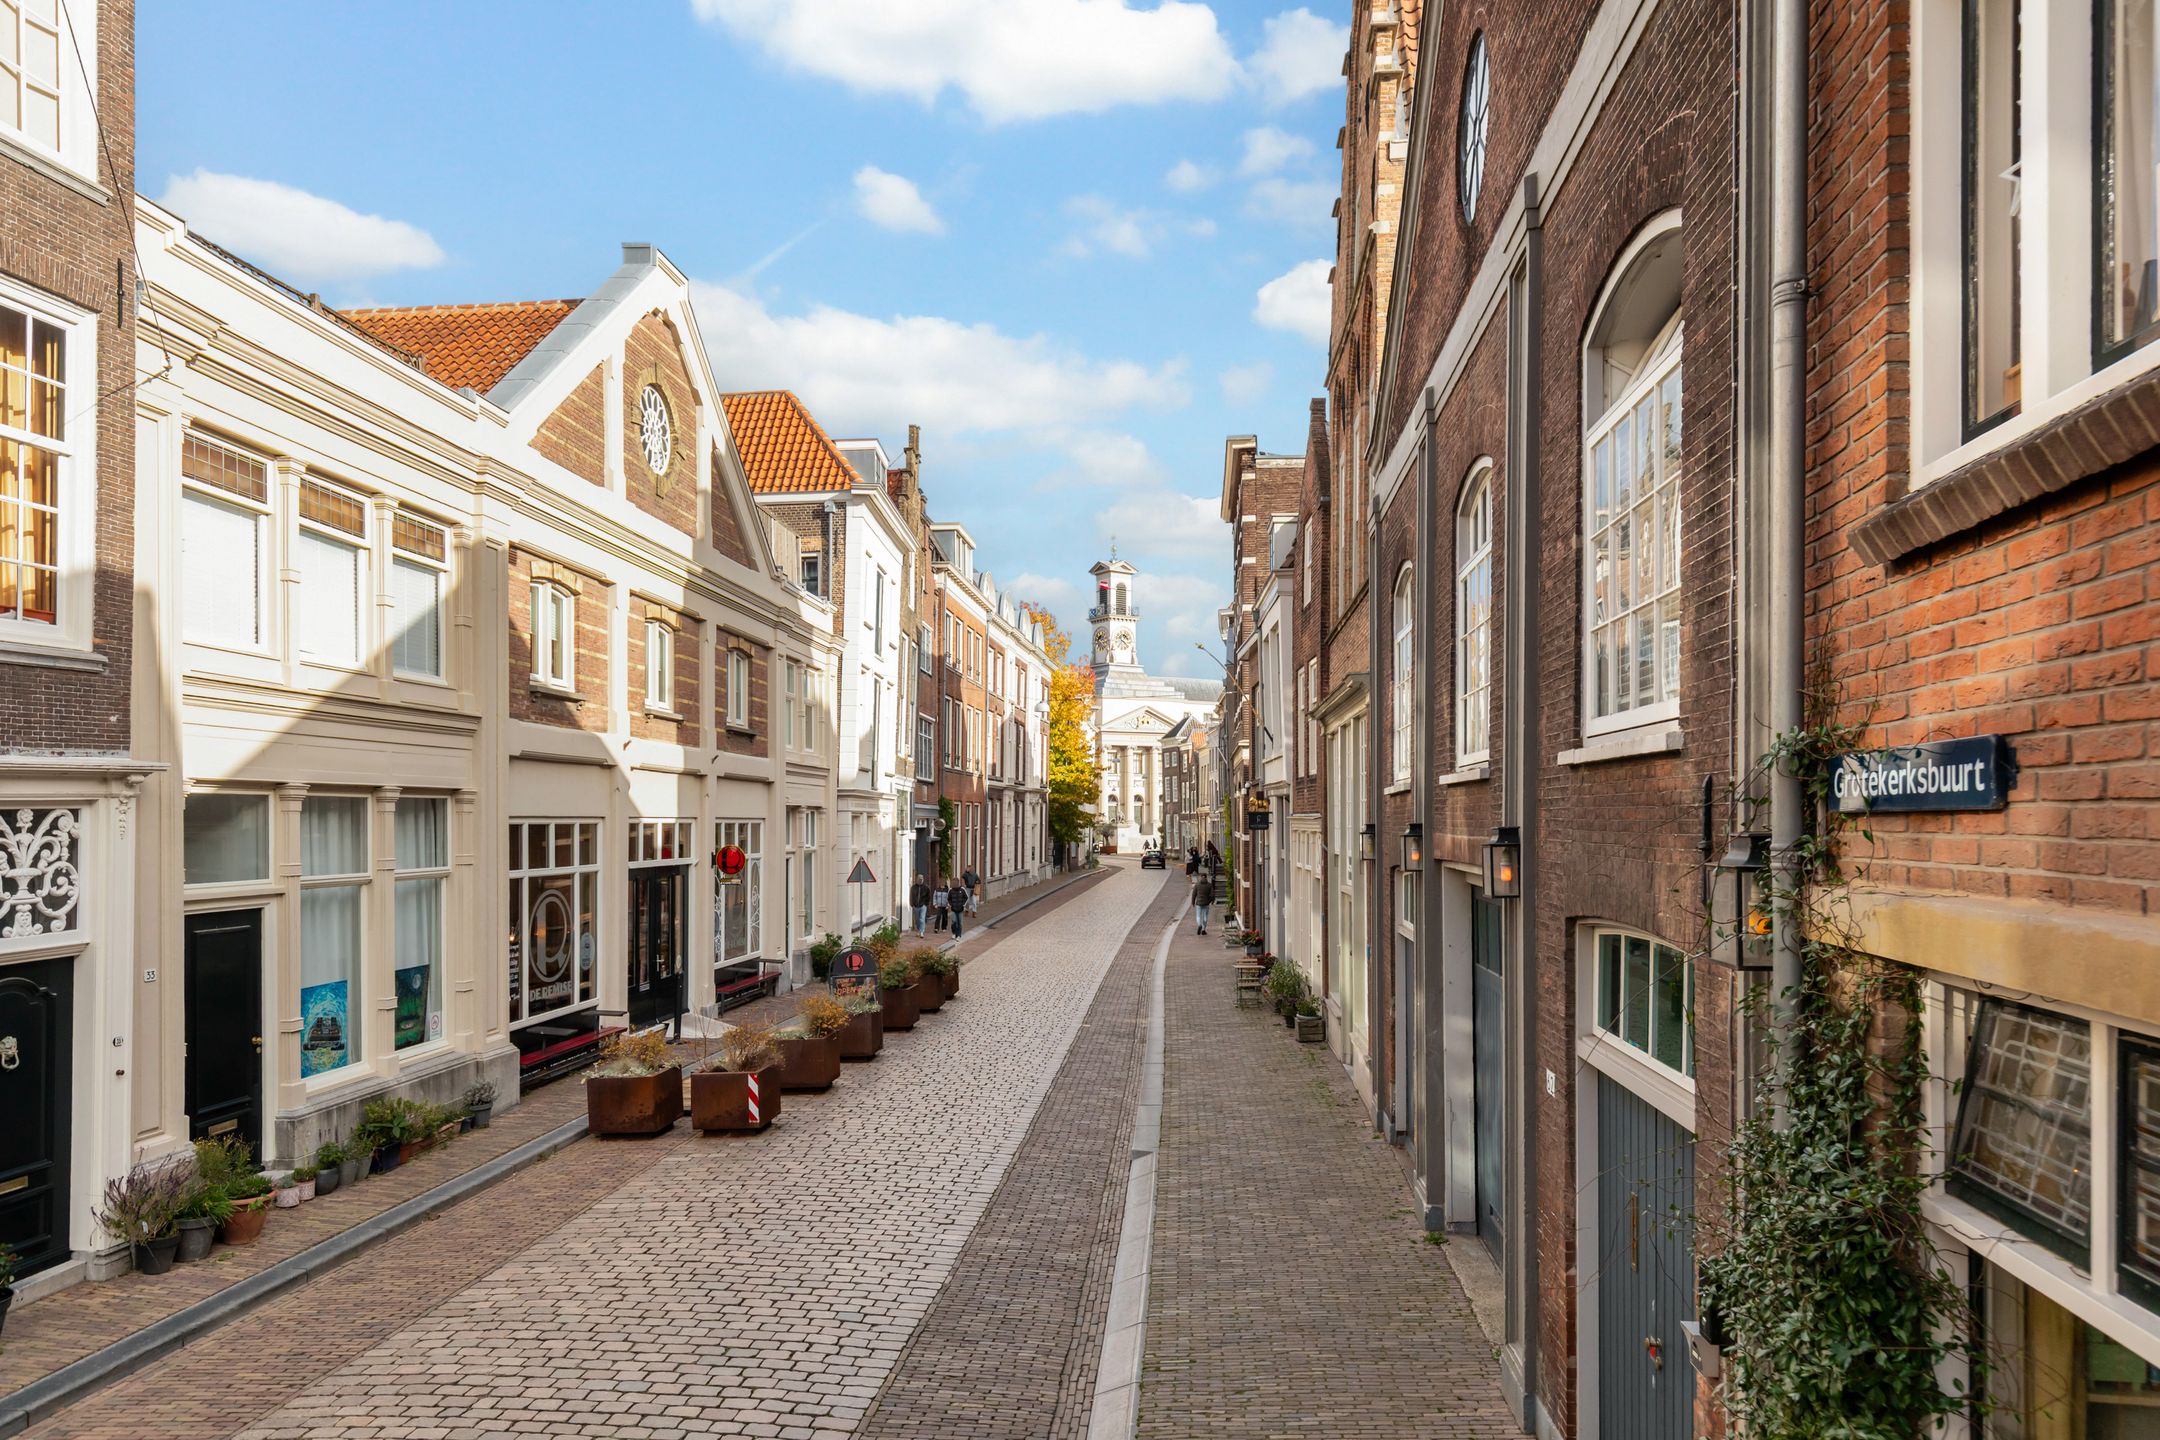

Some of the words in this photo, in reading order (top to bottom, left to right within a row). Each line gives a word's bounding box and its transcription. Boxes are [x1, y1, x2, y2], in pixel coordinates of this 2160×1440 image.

[1834, 758, 1985, 798] Grotekerksbuurt
[146, 970, 156, 980] 33
[529, 988, 541, 1002] DE
[542, 980, 573, 999] REMISE
